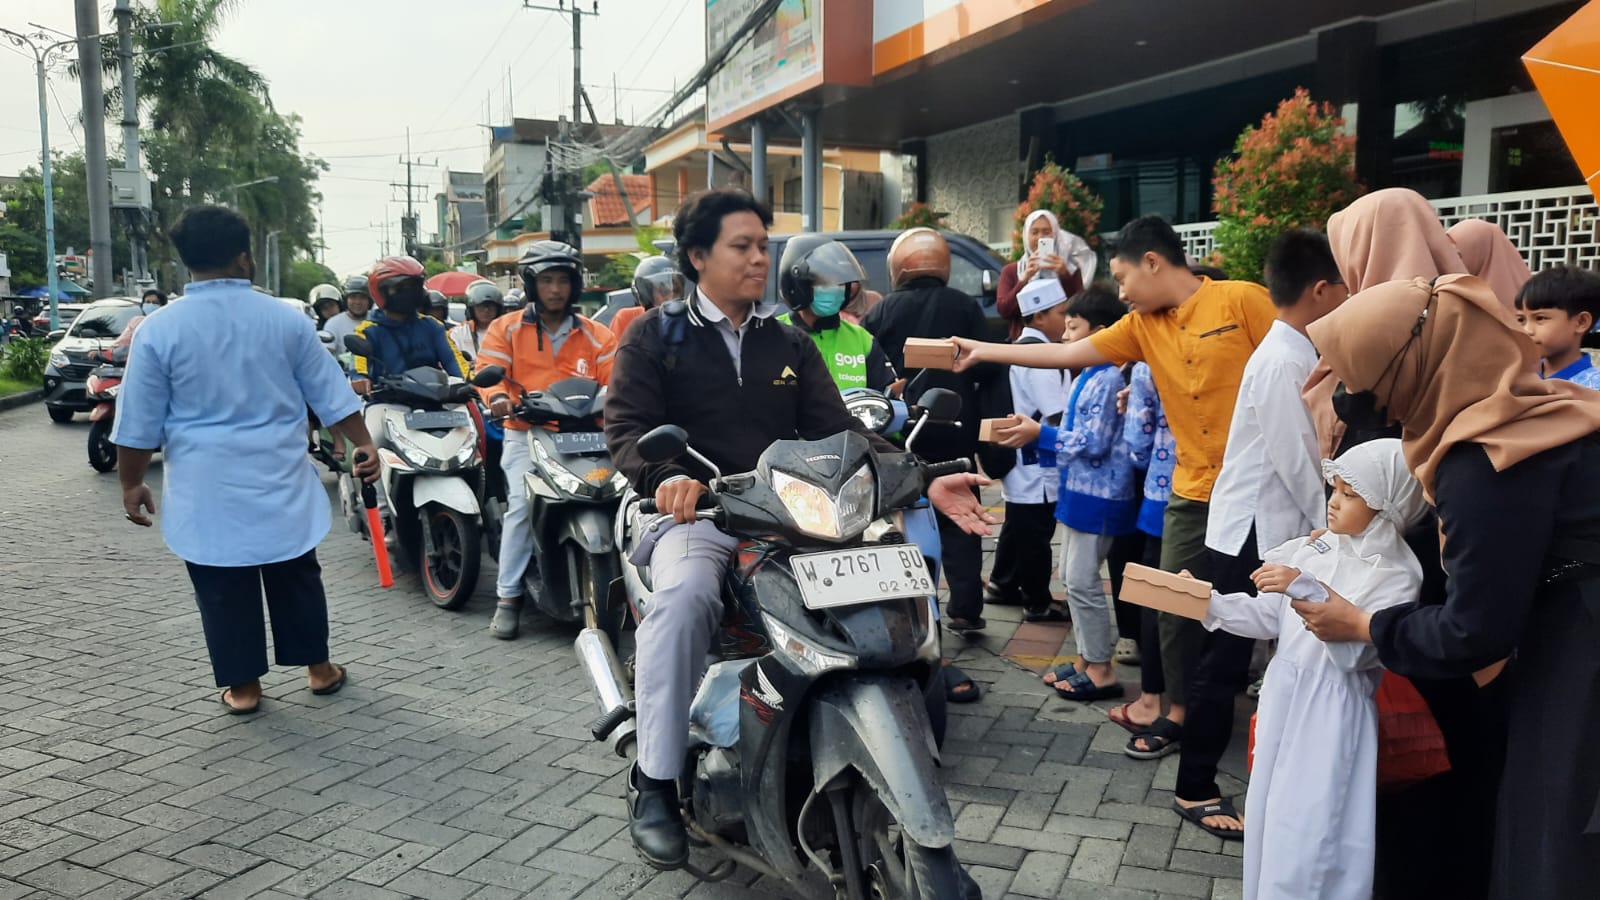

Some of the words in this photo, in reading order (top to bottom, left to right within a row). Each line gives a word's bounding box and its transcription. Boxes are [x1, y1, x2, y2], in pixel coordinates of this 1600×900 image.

[806, 454, 841, 462] HONDA
[800, 561, 818, 582] W
[831, 553, 880, 577] 2767
[898, 549, 923, 569] BU
[752, 688, 785, 711] HONDA
